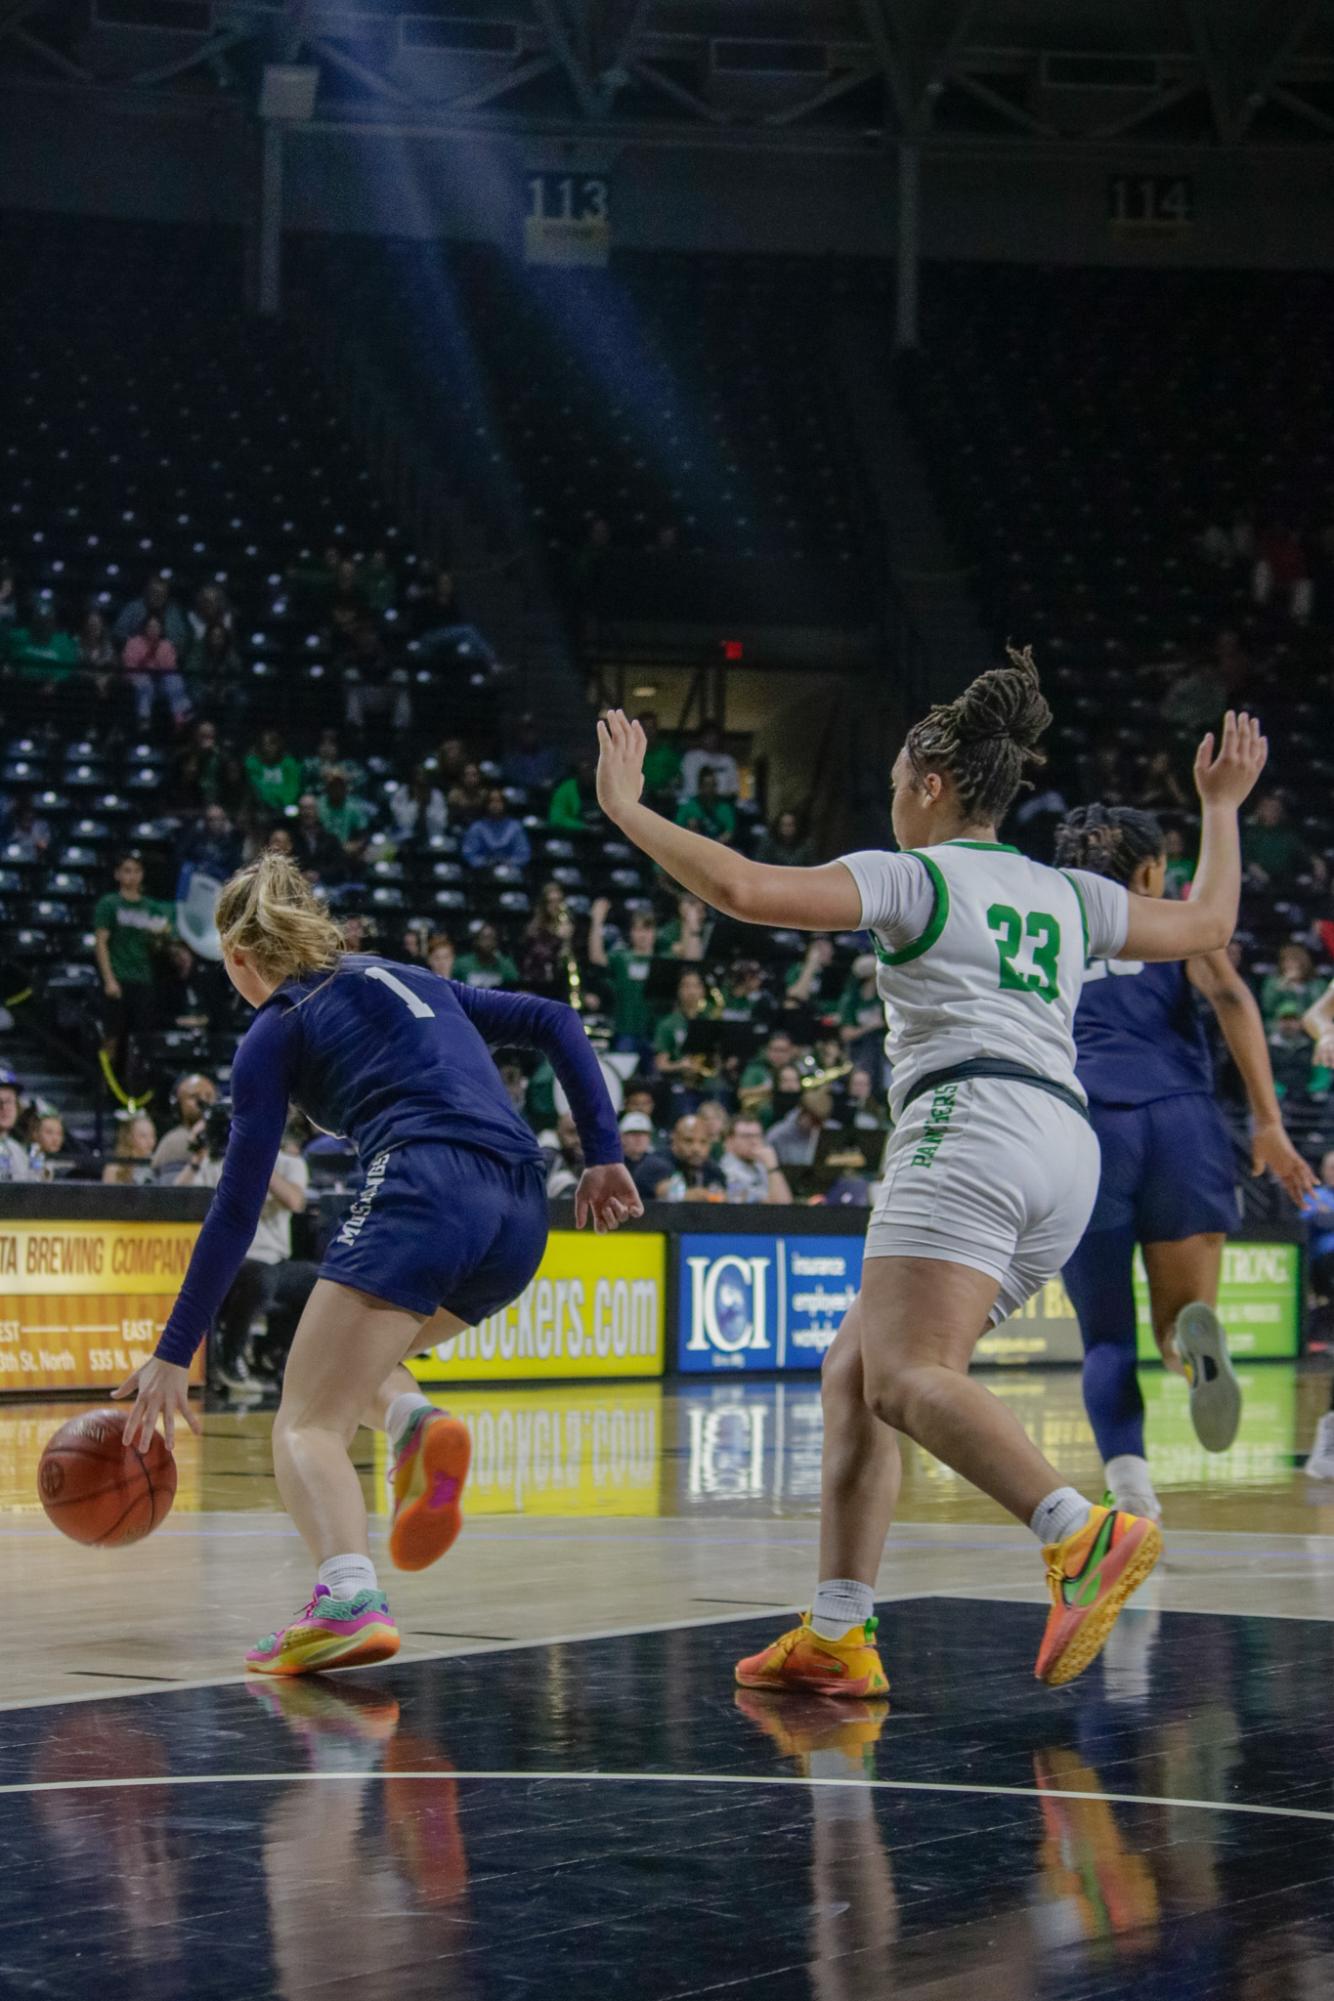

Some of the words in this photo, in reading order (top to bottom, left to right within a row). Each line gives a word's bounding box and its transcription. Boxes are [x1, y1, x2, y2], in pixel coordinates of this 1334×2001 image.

[529, 178, 608, 222] 113
[1112, 180, 1188, 222] 114
[987, 903, 1061, 1004] 23
[364, 966, 436, 1019] 1
[26, 1236, 105, 1275] BREWING
[112, 1238, 192, 1275] COMPAN
[686, 1253, 771, 1351] ICI
[121, 1319, 153, 1341] EAST
[39, 1349, 76, 1372] North
[89, 1349, 113, 1371] 535
